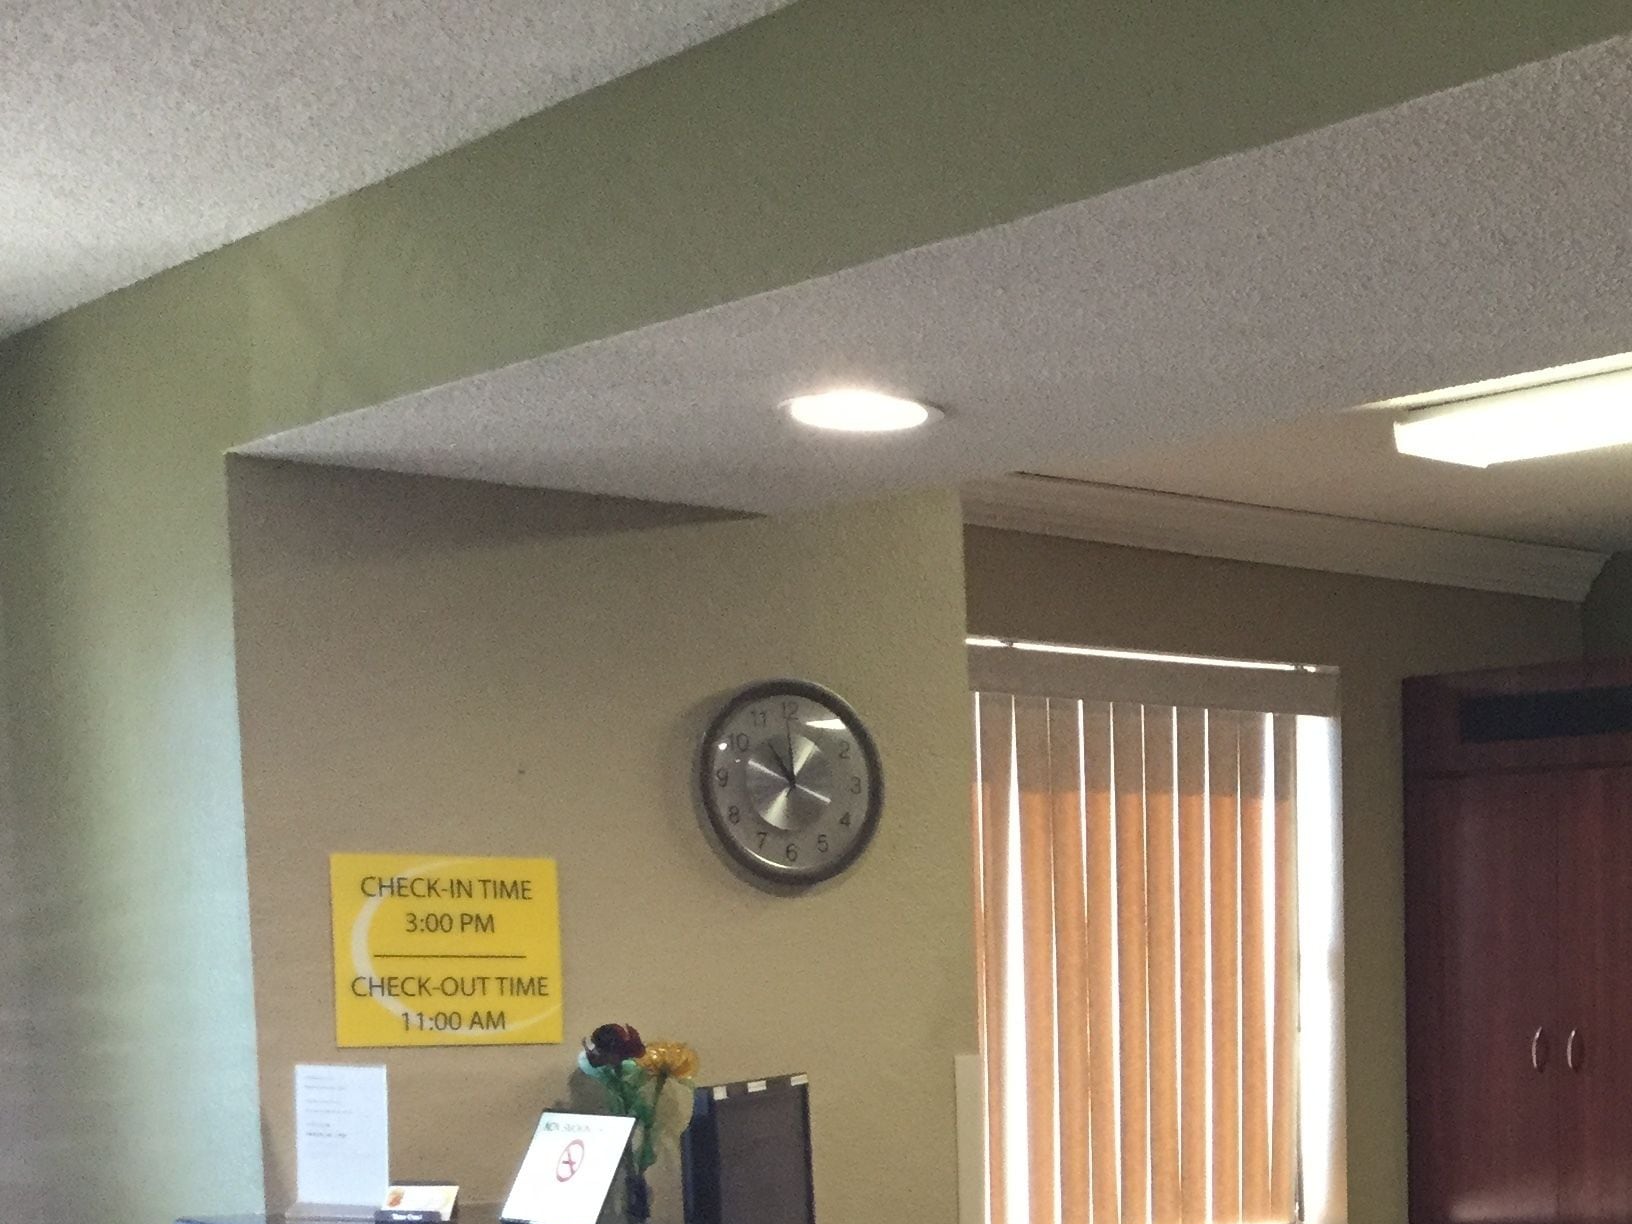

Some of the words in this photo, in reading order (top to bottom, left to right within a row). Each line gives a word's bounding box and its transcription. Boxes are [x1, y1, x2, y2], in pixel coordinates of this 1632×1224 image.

[729, 732, 750, 752] 10
[715, 768, 729, 788] 9
[850, 775, 862, 795] 3
[727, 805, 741, 826] 8
[838, 811, 852, 828] 4
[756, 831, 769, 850] 7
[817, 833, 829, 853] 5
[785, 843, 799, 863] 6
[360, 876, 473, 899] CHECK-IN
[478, 879, 533, 900] TIME
[405, 912, 453, 933] 3:00
[460, 913, 496, 934] PM
[351, 976, 490, 997] CHECK-OUT
[495, 976, 549, 997] TIME
[401, 1011, 462, 1031] 11:00
[468, 1010, 506, 1031] AM
